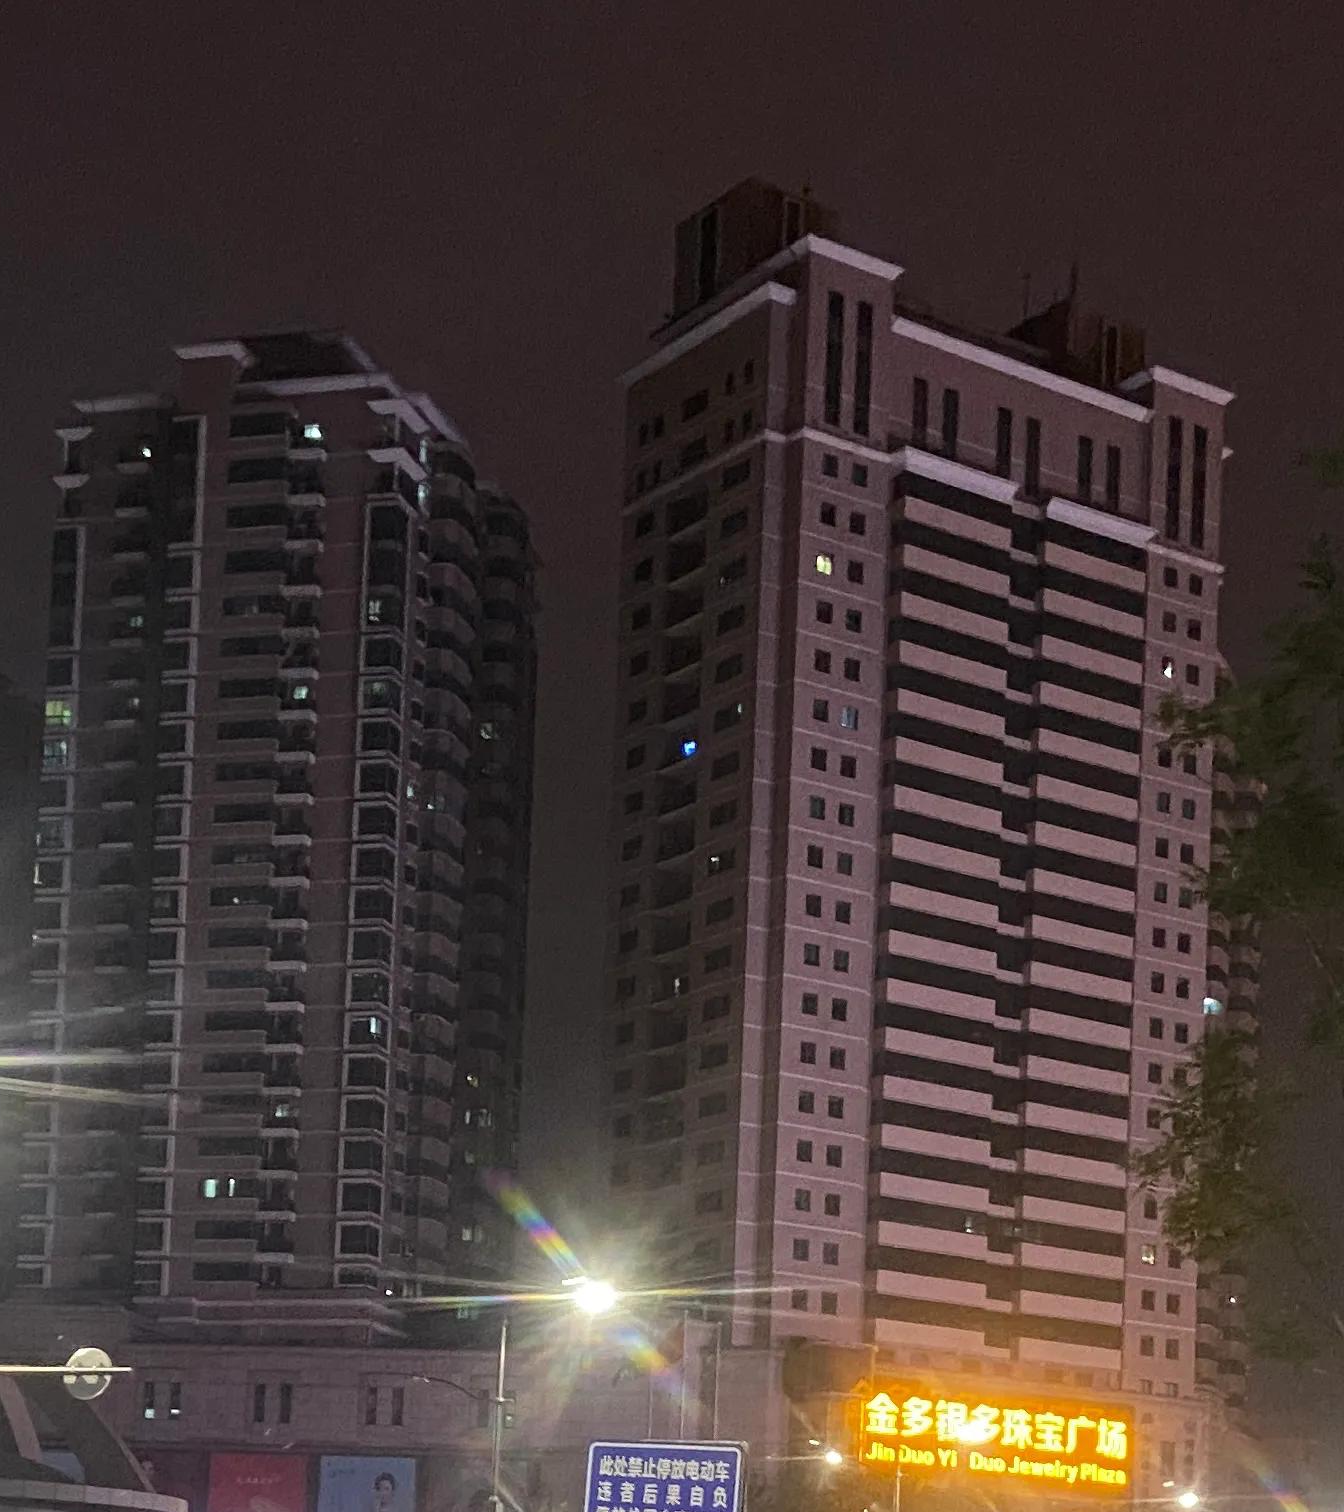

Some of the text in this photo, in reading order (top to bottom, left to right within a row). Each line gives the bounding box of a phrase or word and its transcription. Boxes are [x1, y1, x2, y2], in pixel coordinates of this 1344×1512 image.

[865, 1392, 1127, 1460] 金多银多珠宝广场
[599, 1455, 730, 1483] 此处禁止停放电动车
[866, 1441, 895, 1462] Jin
[899, 1444, 935, 1466] Duo
[969, 1452, 1006, 1473] Duo
[1008, 1455, 1078, 1483] Jewelry
[1080, 1462, 1127, 1485] Plaza
[597, 1481, 728, 1509] 违者后果自负
